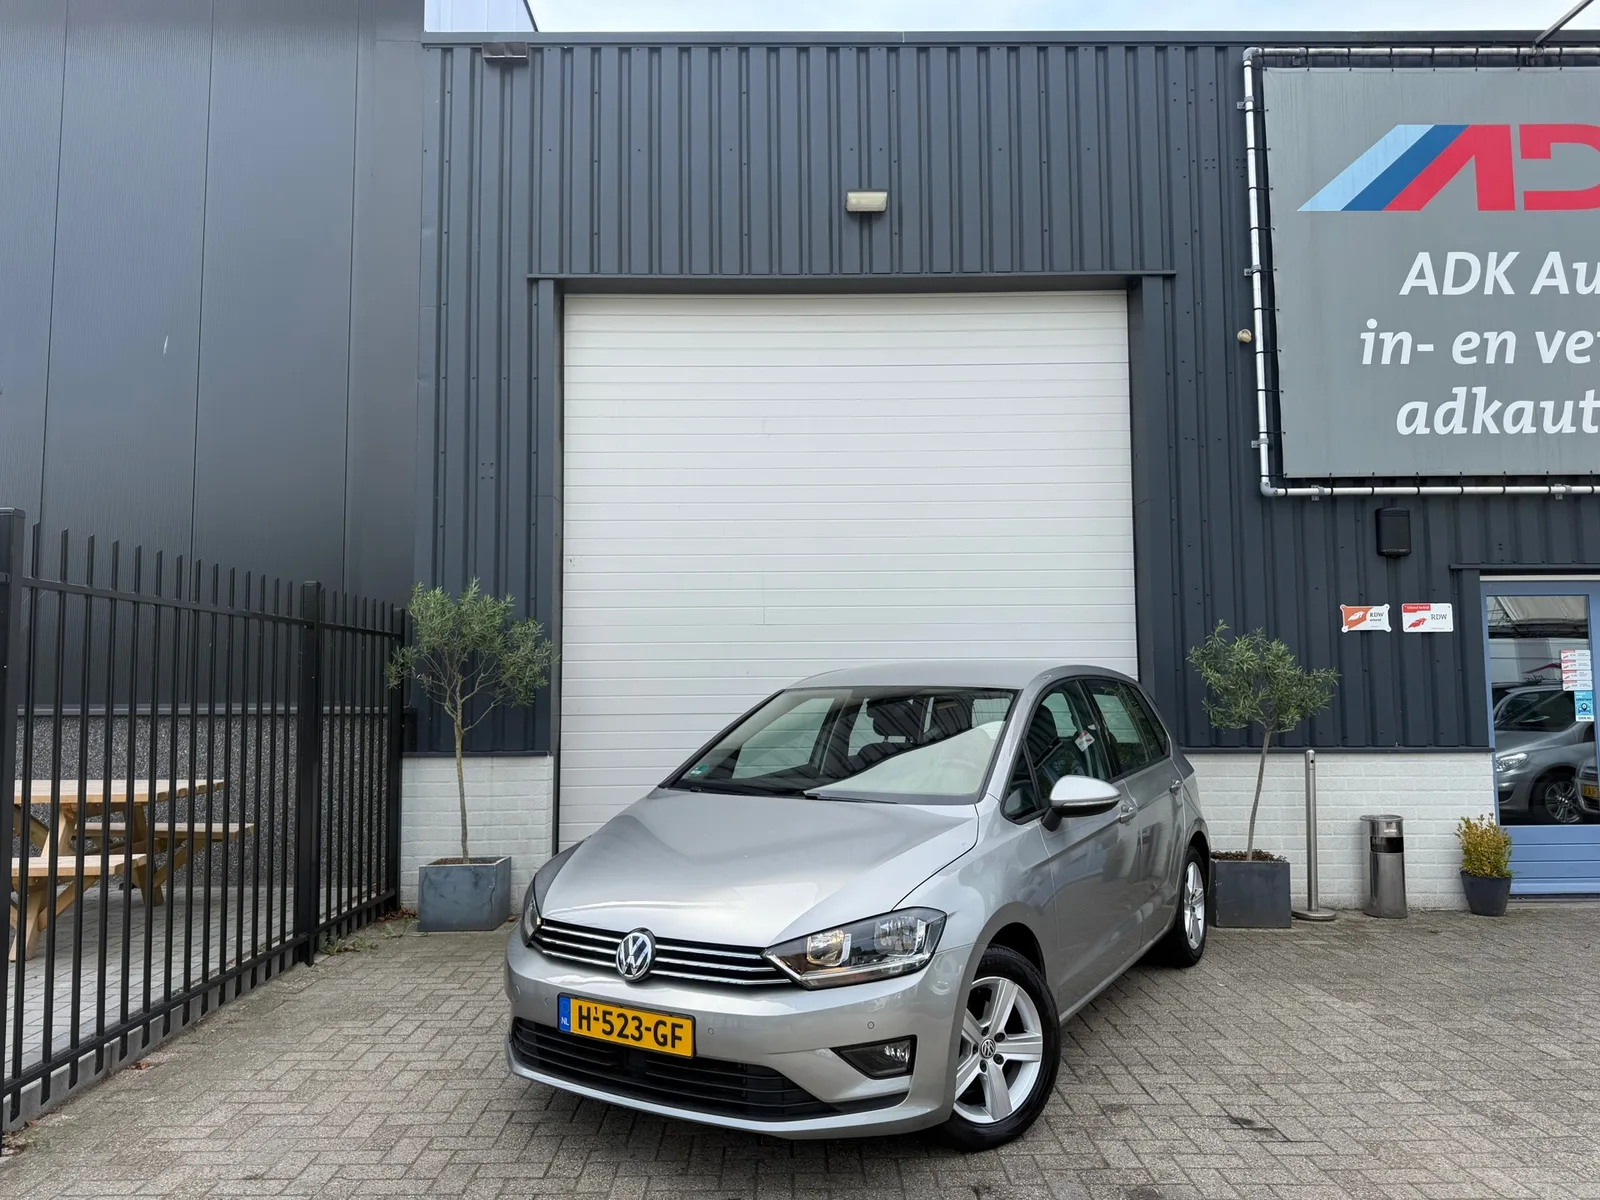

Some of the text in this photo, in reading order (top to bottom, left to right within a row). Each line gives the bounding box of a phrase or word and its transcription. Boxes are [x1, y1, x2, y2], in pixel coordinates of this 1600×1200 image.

[1398, 251, 1600, 296] ADK Au
[1359, 318, 1600, 365] in- en ve
[1396, 386, 1600, 436] adkaut
[1430, 613, 1448, 621] RDW
[560, 1016, 570, 1027] NL
